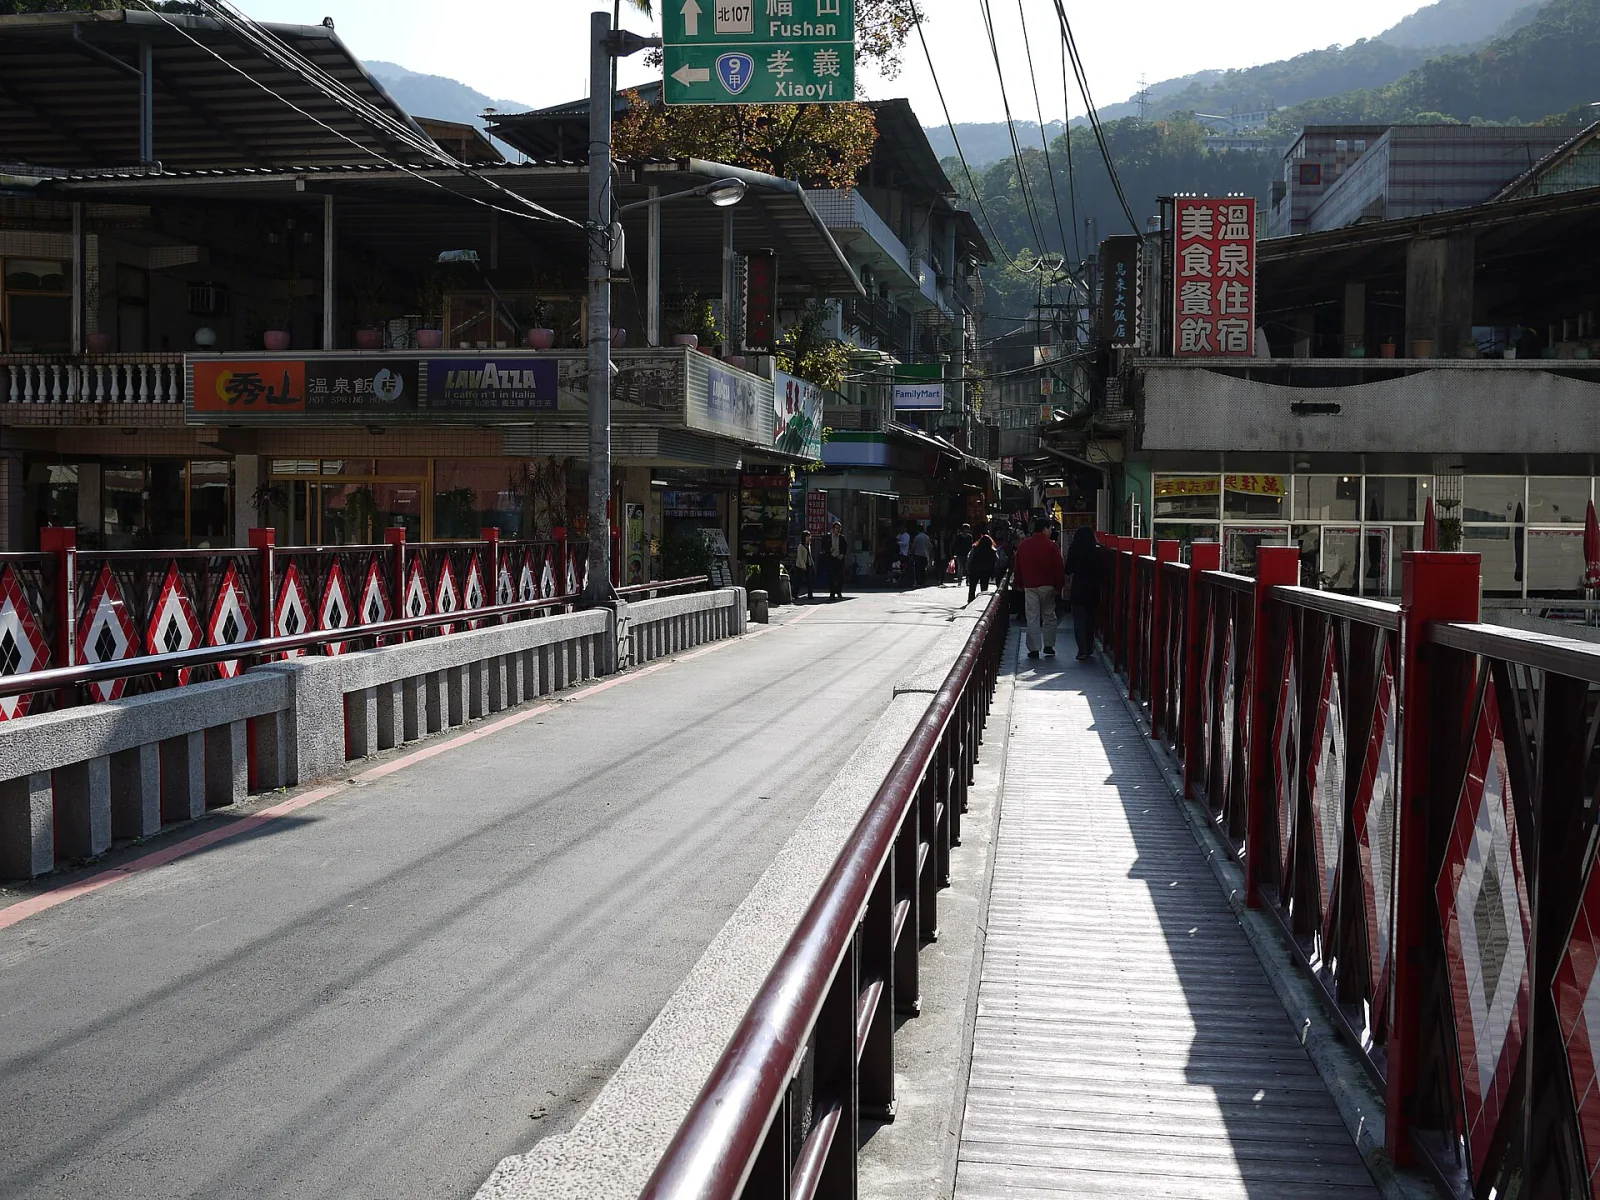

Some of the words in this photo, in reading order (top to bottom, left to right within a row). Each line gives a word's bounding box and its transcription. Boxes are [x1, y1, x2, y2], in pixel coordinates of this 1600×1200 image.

[770, 21, 836, 37] Fushan
[729, 59, 741, 74] 9
[767, 48, 840, 78] 孝義
[729, 74, 741, 89] 甲
[775, 80, 833, 99] Xiaoyi
[1180, 204, 1214, 353] 美食餐飲
[1216, 204, 1250, 353] 溫泉住宿
[1112, 262, 1128, 338] 烏來大飯店
[445, 362, 536, 389] LAVAZZA
[224, 369, 304, 406] 秀山
[308, 377, 397, 394] 溫泉飯店
[499, 391, 510, 399] in
[511, 390, 536, 399] Italia
[308, 396, 325, 404] HOT
[330, 396, 364, 404] SPRING
[895, 389, 940, 401] FamilyMart
